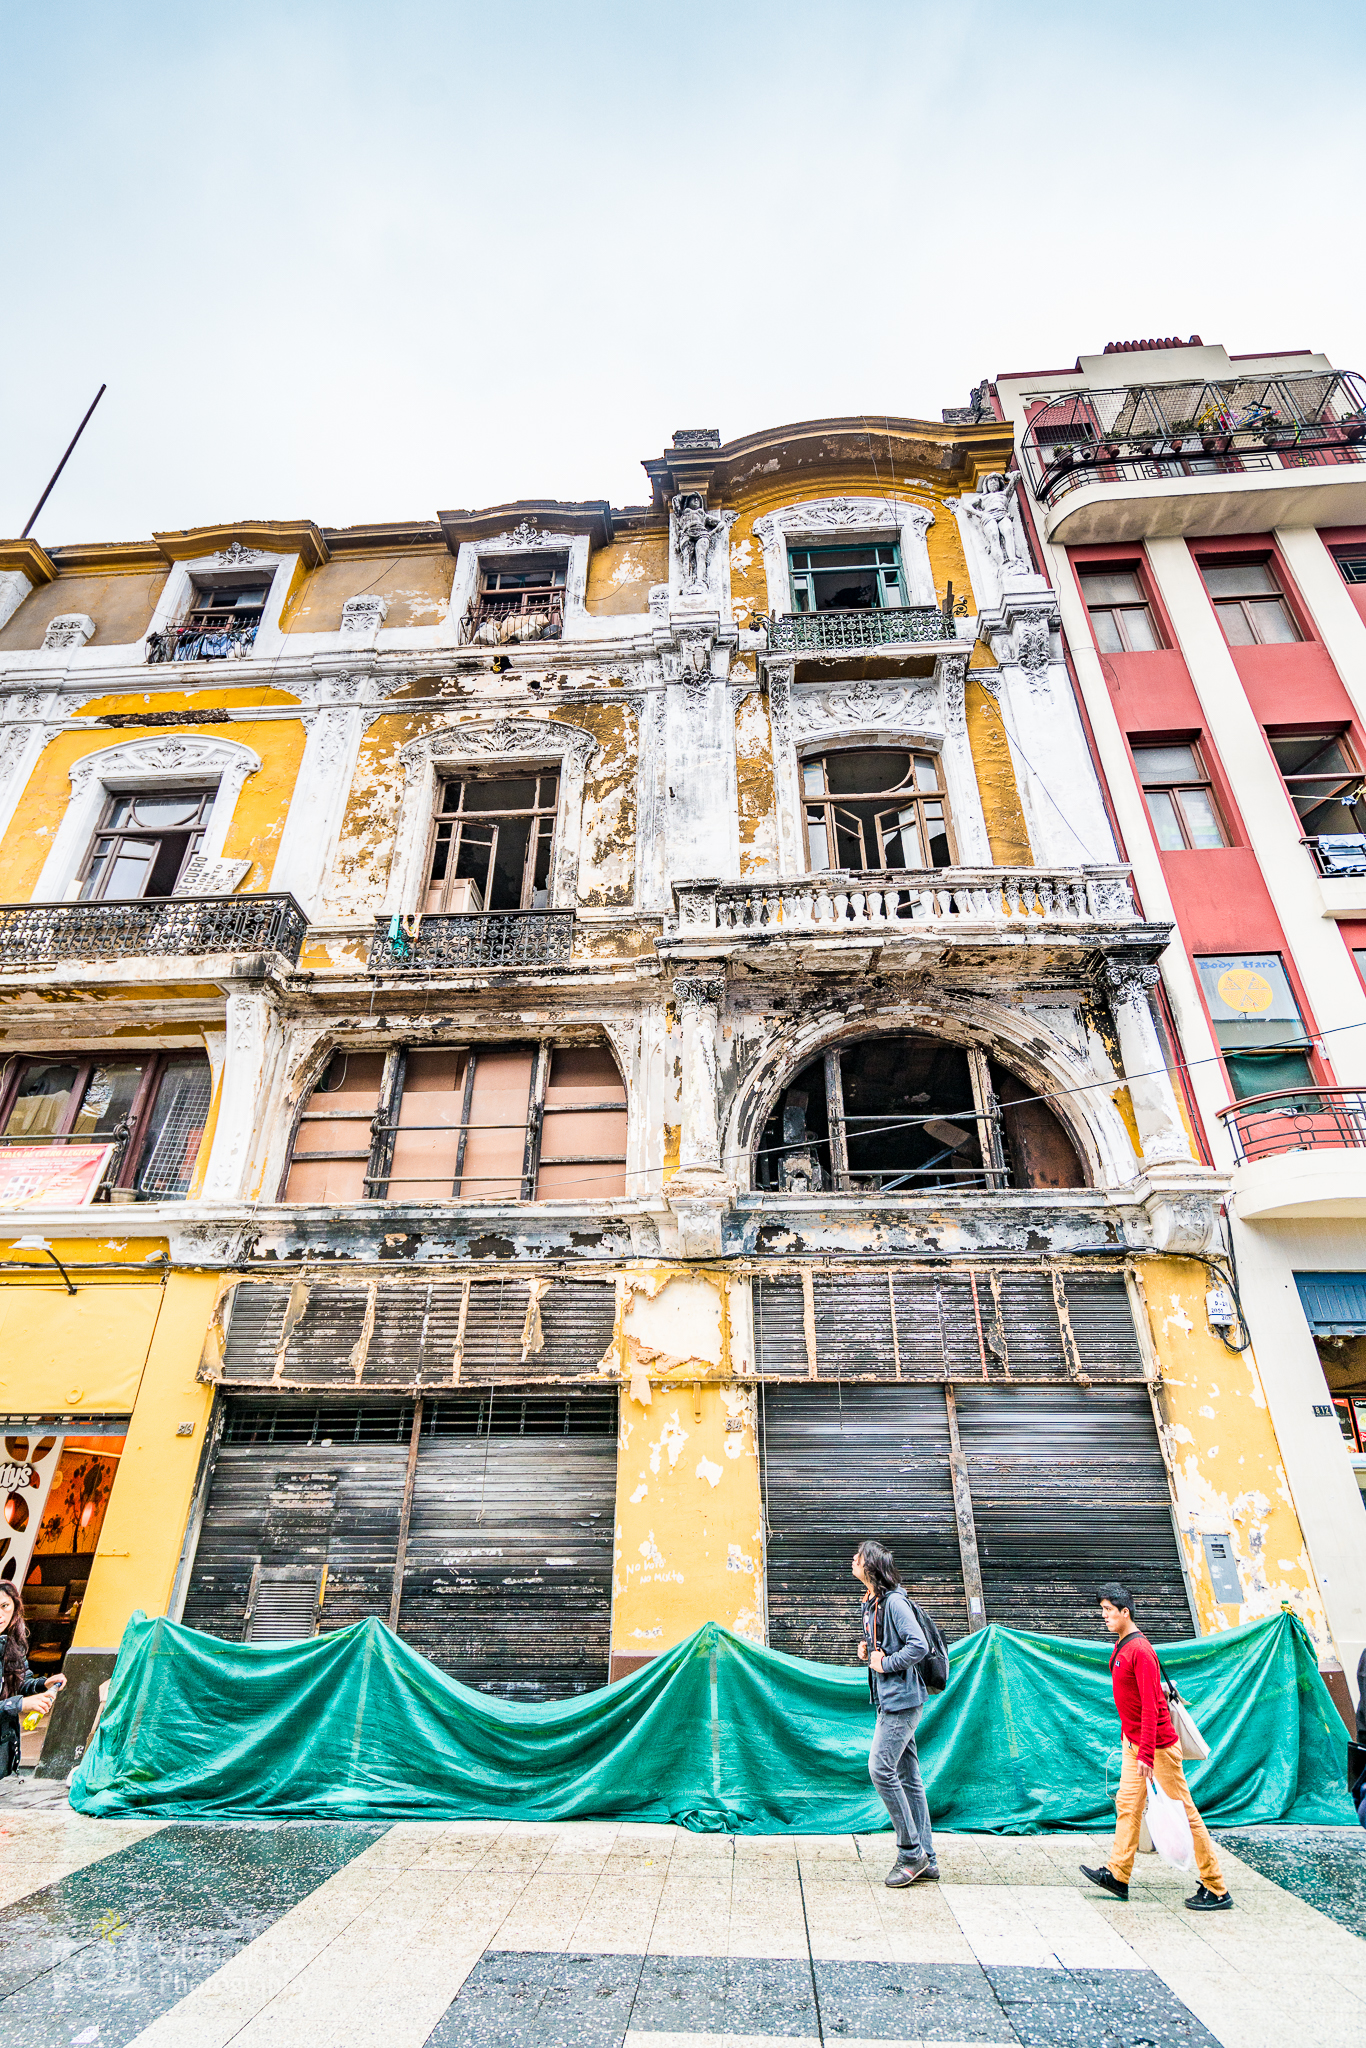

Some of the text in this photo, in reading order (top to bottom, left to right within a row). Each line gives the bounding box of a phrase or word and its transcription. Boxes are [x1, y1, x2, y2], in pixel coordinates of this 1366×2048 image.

[183, 856, 209, 885] CUERO
[1198, 959, 1277, 971] Body Hard
[0, 1150, 21, 1158] NDAS
[34, 1149, 62, 1158] CUERO
[1315, 1406, 1330, 1414] 812
[626, 1563, 641, 1579] NO
